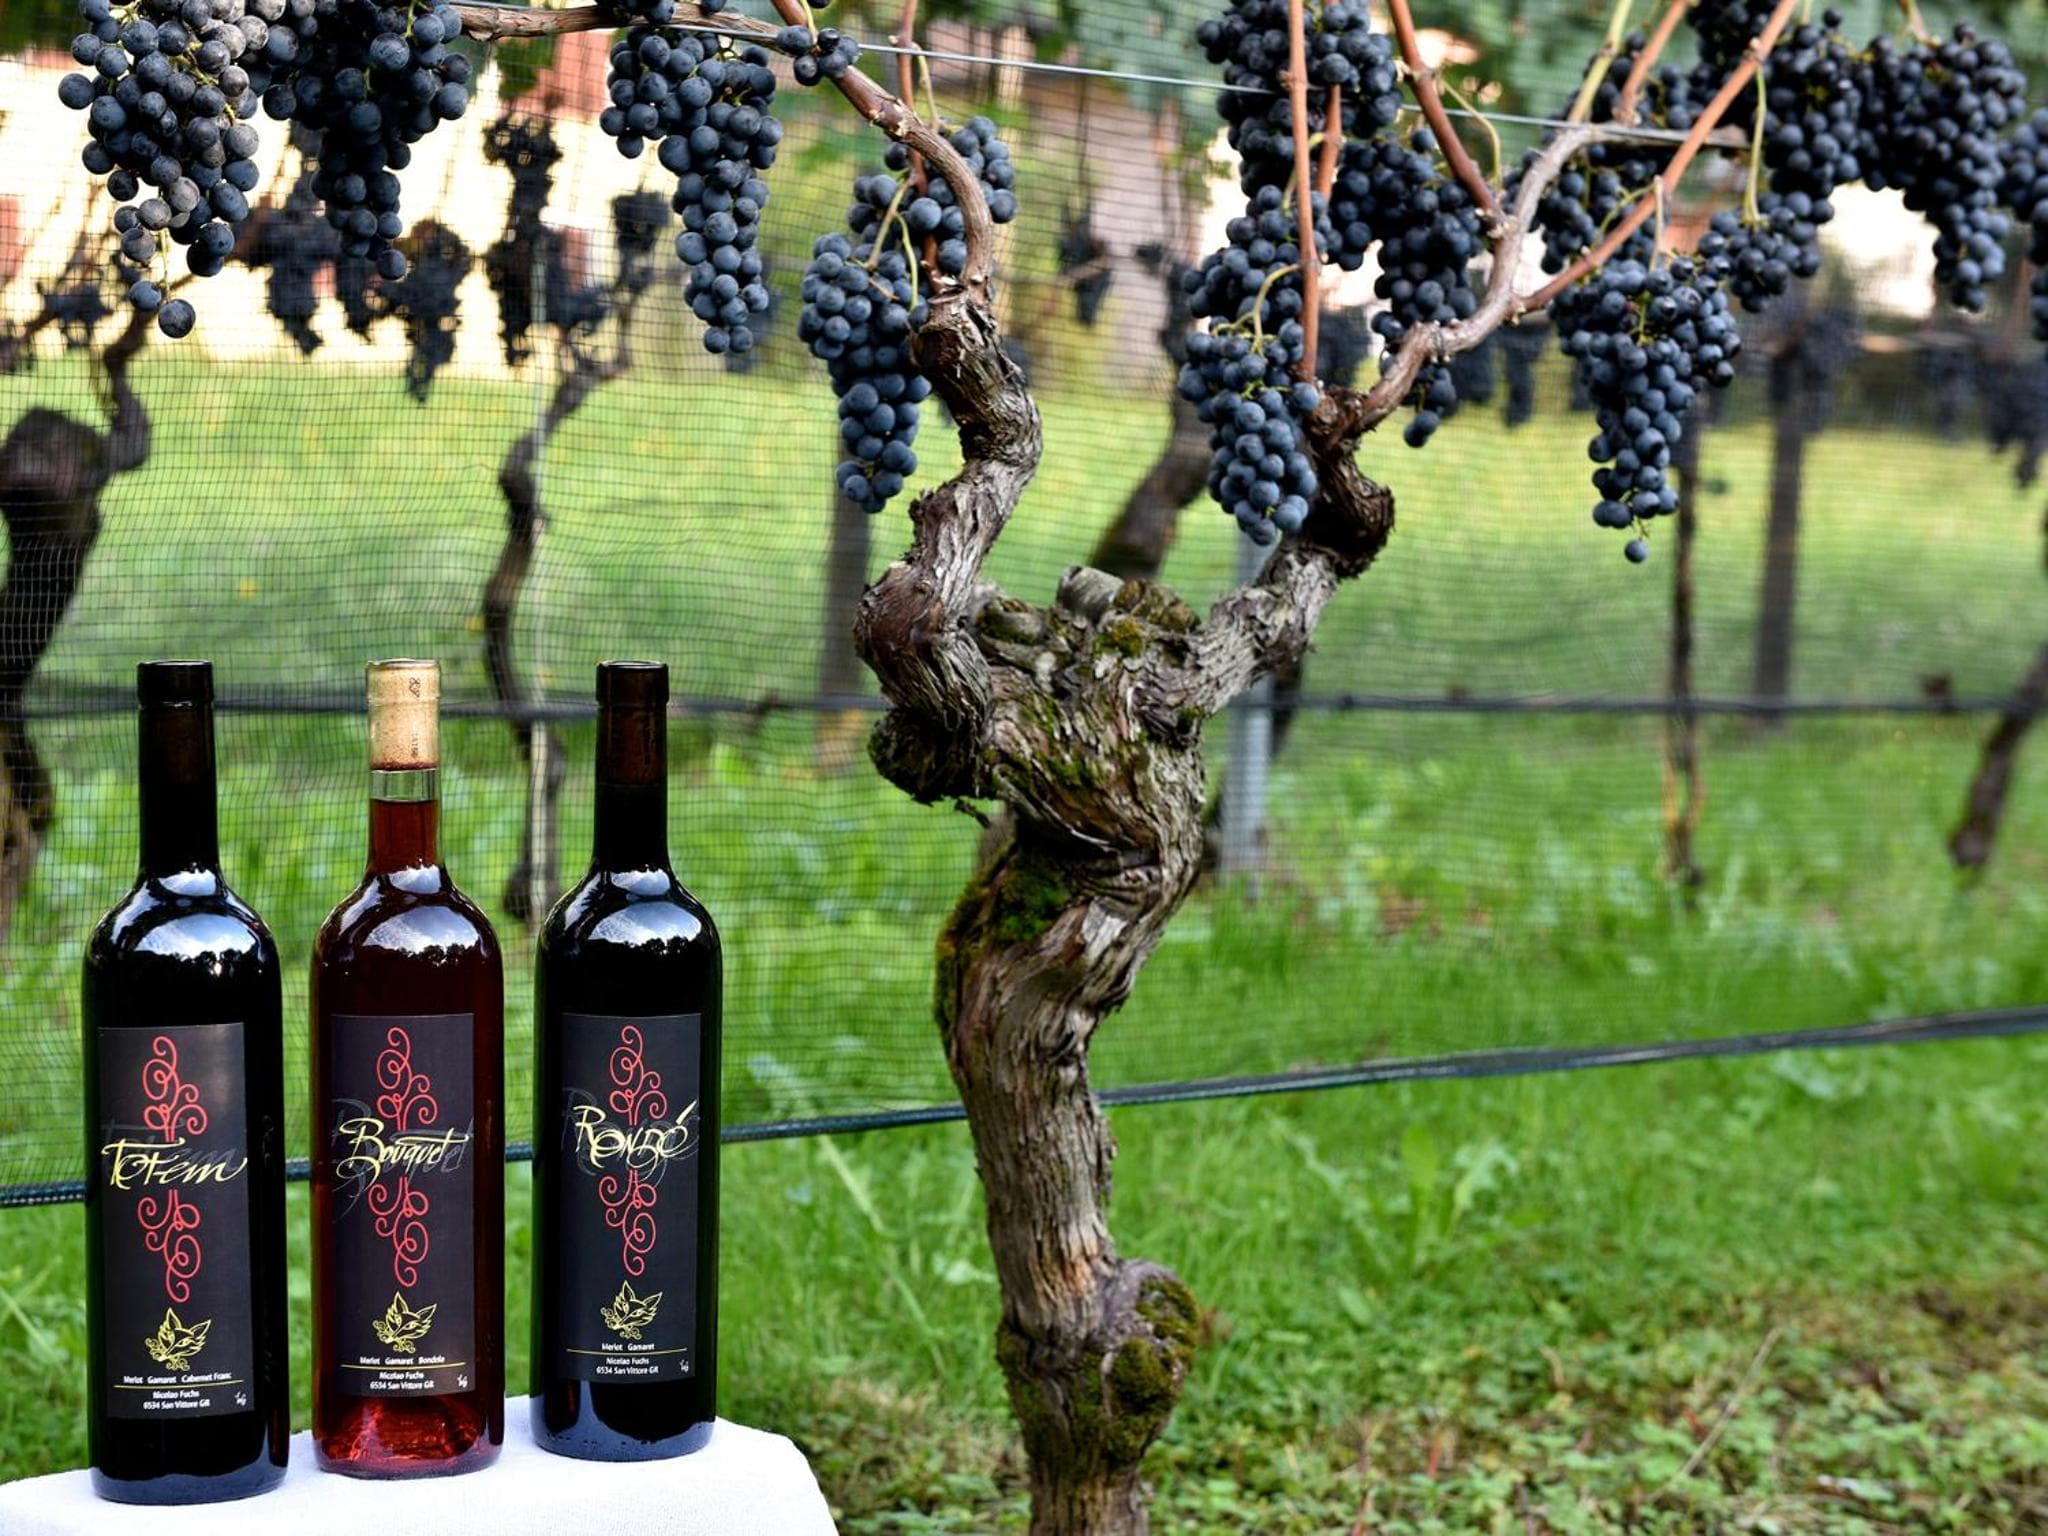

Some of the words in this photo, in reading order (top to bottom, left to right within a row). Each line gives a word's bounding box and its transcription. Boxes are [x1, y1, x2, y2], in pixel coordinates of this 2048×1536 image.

[335, 1117, 470, 1192] Bouquet
[601, 1343, 623, 1351] Merlot
[627, 1343, 655, 1351] Gamaret
[359, 1356, 381, 1365] Merlot
[384, 1356, 414, 1365] Gamaret
[606, 1357, 630, 1365] Nicolao
[631, 1357, 650, 1365] Fuchs
[596, 1366, 613, 1375] 6534
[613, 1366, 626, 1375] San
[626, 1366, 649, 1375] Vittore
[649, 1365, 660, 1374] GR
[123, 1375, 144, 1384] Merlot
[147, 1375, 177, 1384] Gamaret
[181, 1374, 213, 1383] Cabernet
[213, 1372, 232, 1381] Franc
[379, 1371, 405, 1380] Nicolao
[405, 1371, 425, 1380] Fuchs
[369, 1381, 387, 1390] 6534
[387, 1381, 400, 1390] San
[400, 1381, 423, 1390] Vittore
[423, 1380, 434, 1389] GR
[152, 1390, 178, 1399] Nicolao
[179, 1389, 200, 1399] Fuchs
[143, 1401, 160, 1410] 6534
[160, 1400, 174, 1410] San
[174, 1400, 198, 1409] Vittore
[199, 1398, 211, 1408] GR
